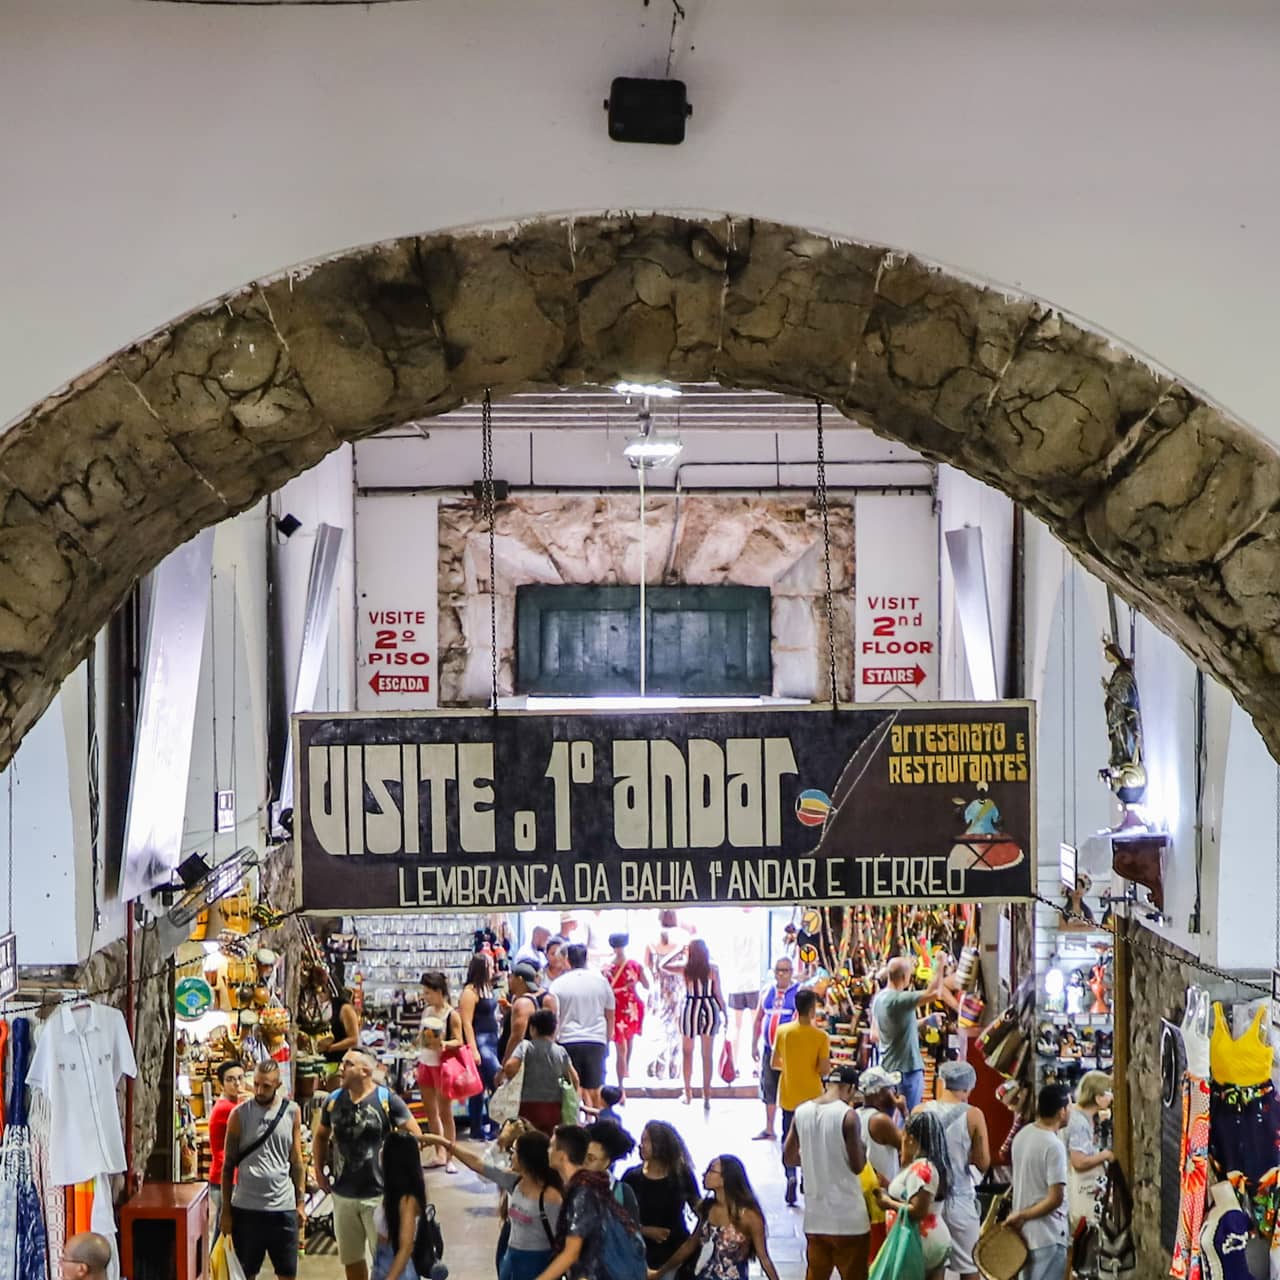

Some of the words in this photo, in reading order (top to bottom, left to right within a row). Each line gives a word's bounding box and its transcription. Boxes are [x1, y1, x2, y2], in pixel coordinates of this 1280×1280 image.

[867, 596, 920, 610] VISIT
[368, 611, 425, 624] VISITE
[872, 612, 922, 636] 2nd
[862, 641, 934, 654] FLOOR
[368, 652, 430, 665] PISO
[866, 669, 914, 682] STAIRS
[379, 677, 425, 690] ESCADA
[1015, 732, 1025, 751] E
[308, 742, 496, 856] VISITE
[398, 863, 567, 906] LEMBRANÇA
[574, 862, 611, 902] DA
[621, 860, 698, 901] BAHIA
[727, 858, 817, 899] ANDAR
[827, 858, 846, 896] E
[855, 853, 966, 896] TÉRREO
